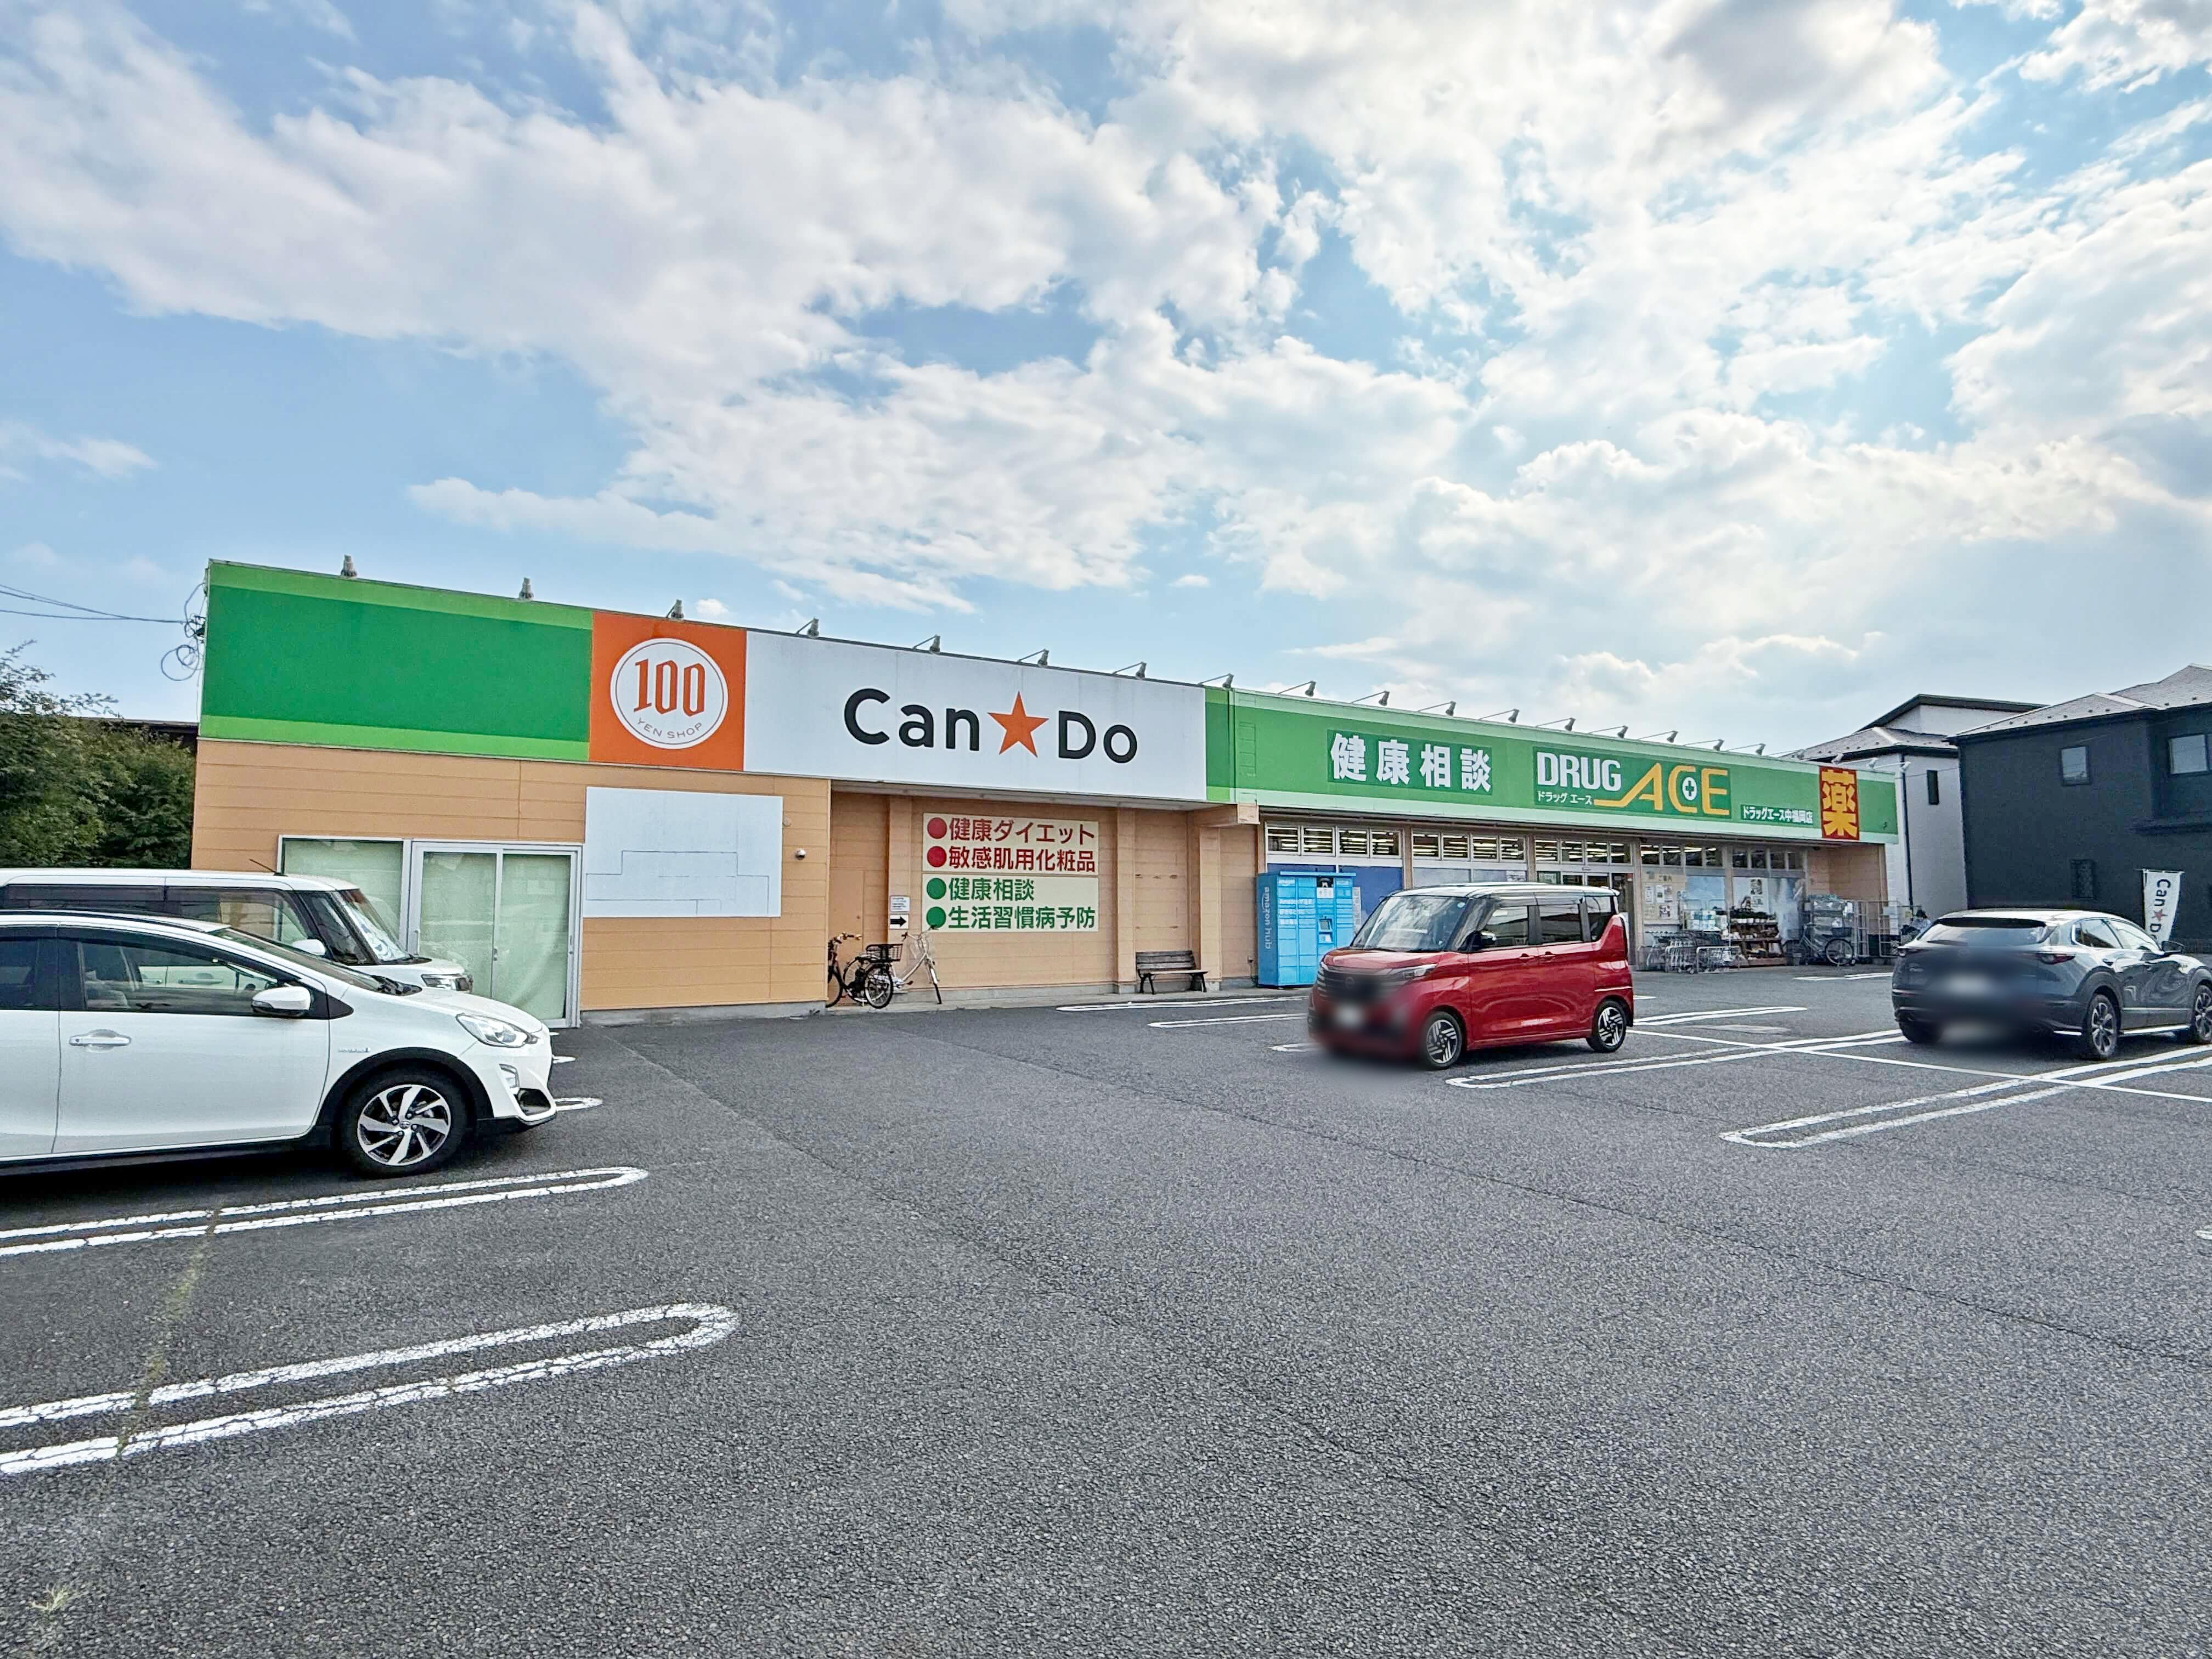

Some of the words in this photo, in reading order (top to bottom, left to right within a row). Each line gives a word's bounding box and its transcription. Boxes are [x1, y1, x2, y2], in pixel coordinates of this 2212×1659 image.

[633, 658, 706, 717] 100
[636, 718, 662, 737] YEN
[667, 722, 702, 739] SHOP
[844, 687, 980, 752] Can
[1058, 710, 1138, 764] Do
[1330, 733, 1491, 792] 健康相談
[1537, 752, 1622, 792] DRUG
[1593, 763, 1730, 816] ACE
[1821, 769, 1858, 838] 薬
[949, 817, 1095, 846] 健康ダイエット
[949, 846, 1096, 873] 敏感肌用化粧品
[949, 877, 1035, 901] 健康相談
[2154, 879, 2171, 906] Can
[948, 906, 1095, 929] 生活習慣病予防
